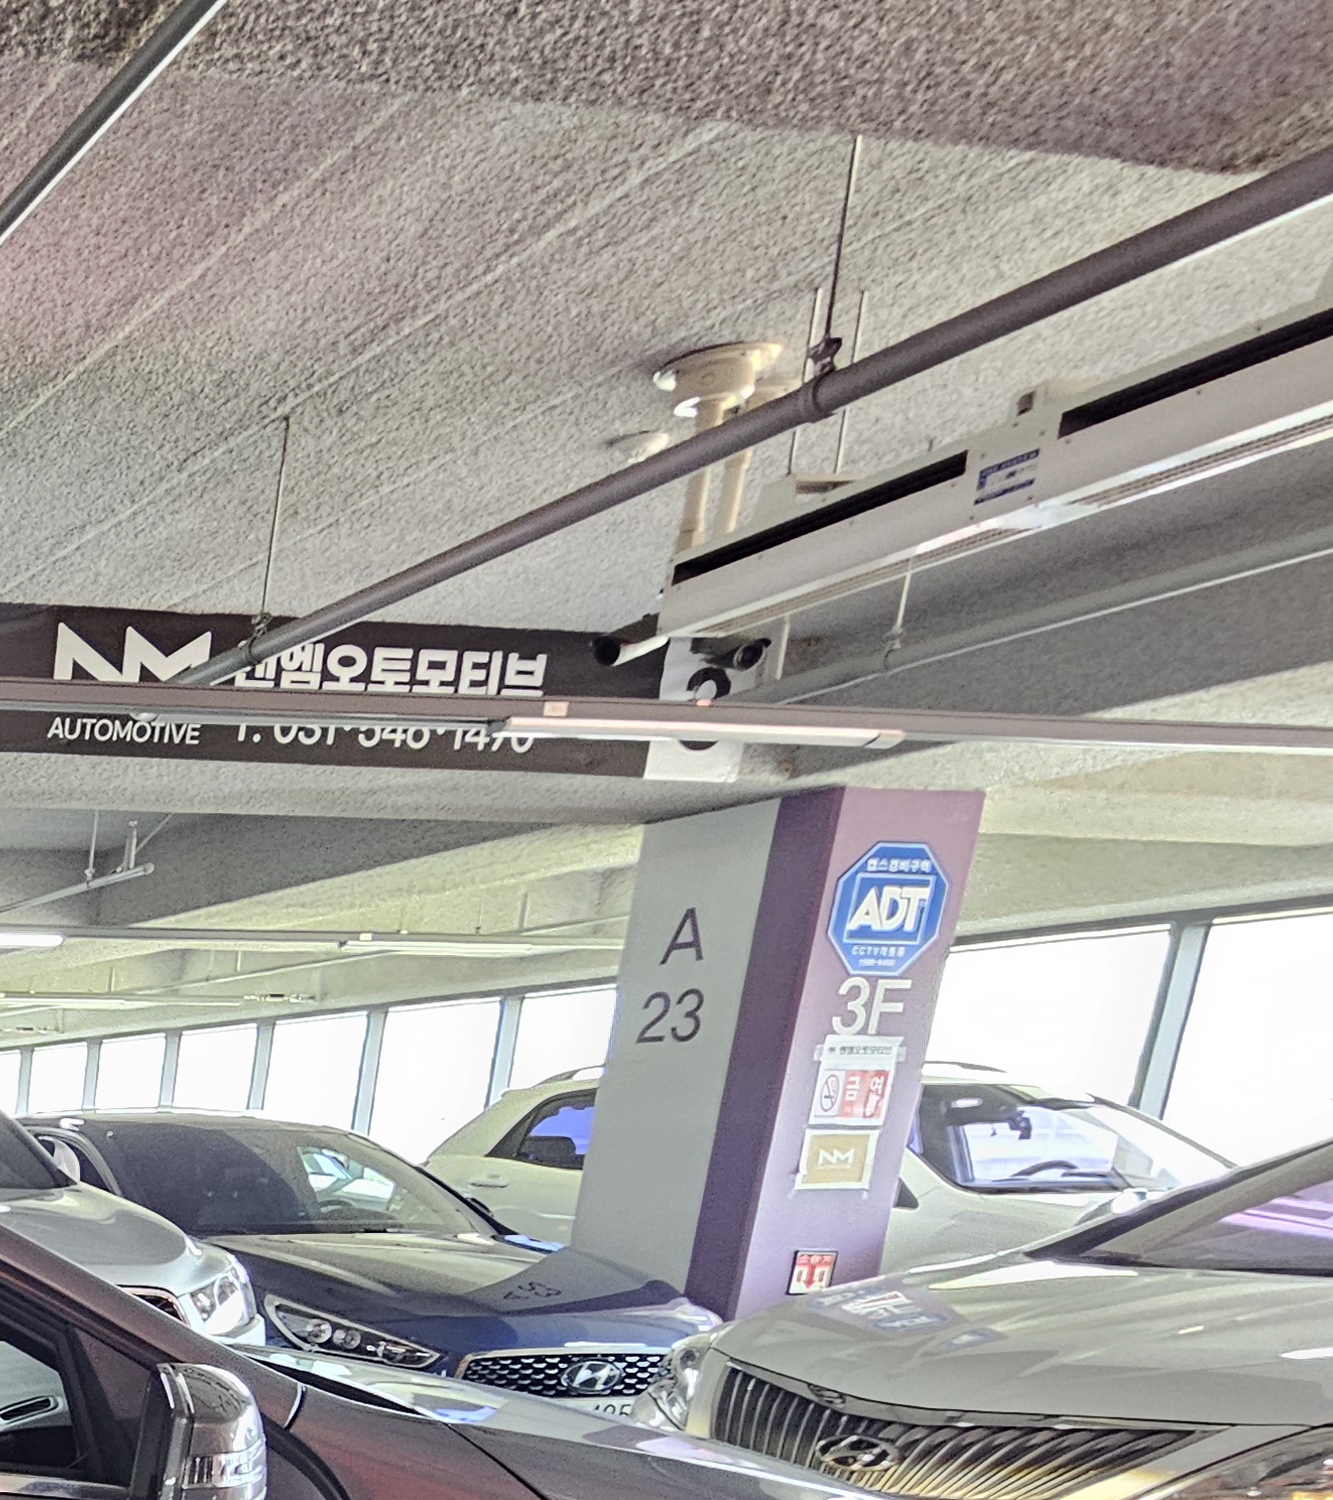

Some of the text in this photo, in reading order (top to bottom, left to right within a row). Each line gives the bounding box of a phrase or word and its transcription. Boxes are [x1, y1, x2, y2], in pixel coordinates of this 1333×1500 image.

[47, 717, 202, 745] AUTOMOTIVE
[659, 908, 704, 966] A
[847, 885, 931, 933] ADT
[635, 988, 704, 1044] 23
[831, 977, 913, 1035] 3F
